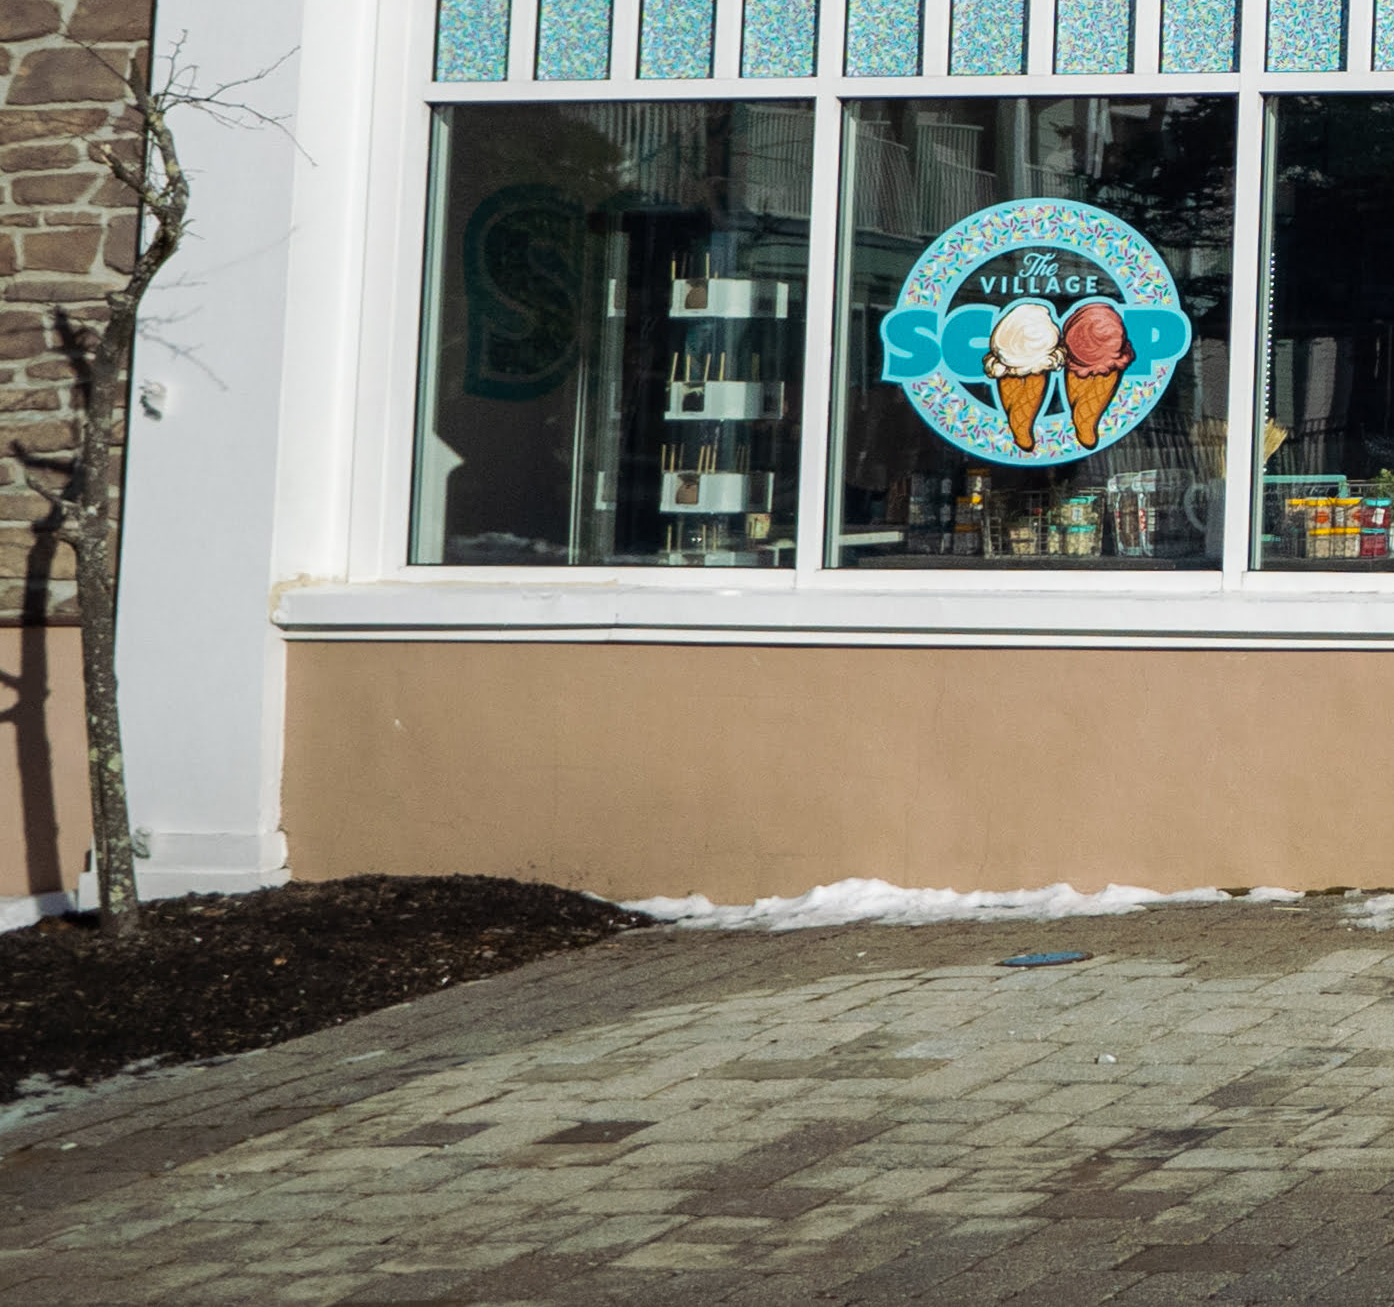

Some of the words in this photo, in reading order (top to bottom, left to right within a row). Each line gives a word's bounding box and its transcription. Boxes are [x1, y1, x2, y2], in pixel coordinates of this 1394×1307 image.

[1019, 252, 1059, 277] The
[980, 276, 1098, 294] VILLAGE
[884, 307, 1188, 379] SCP
